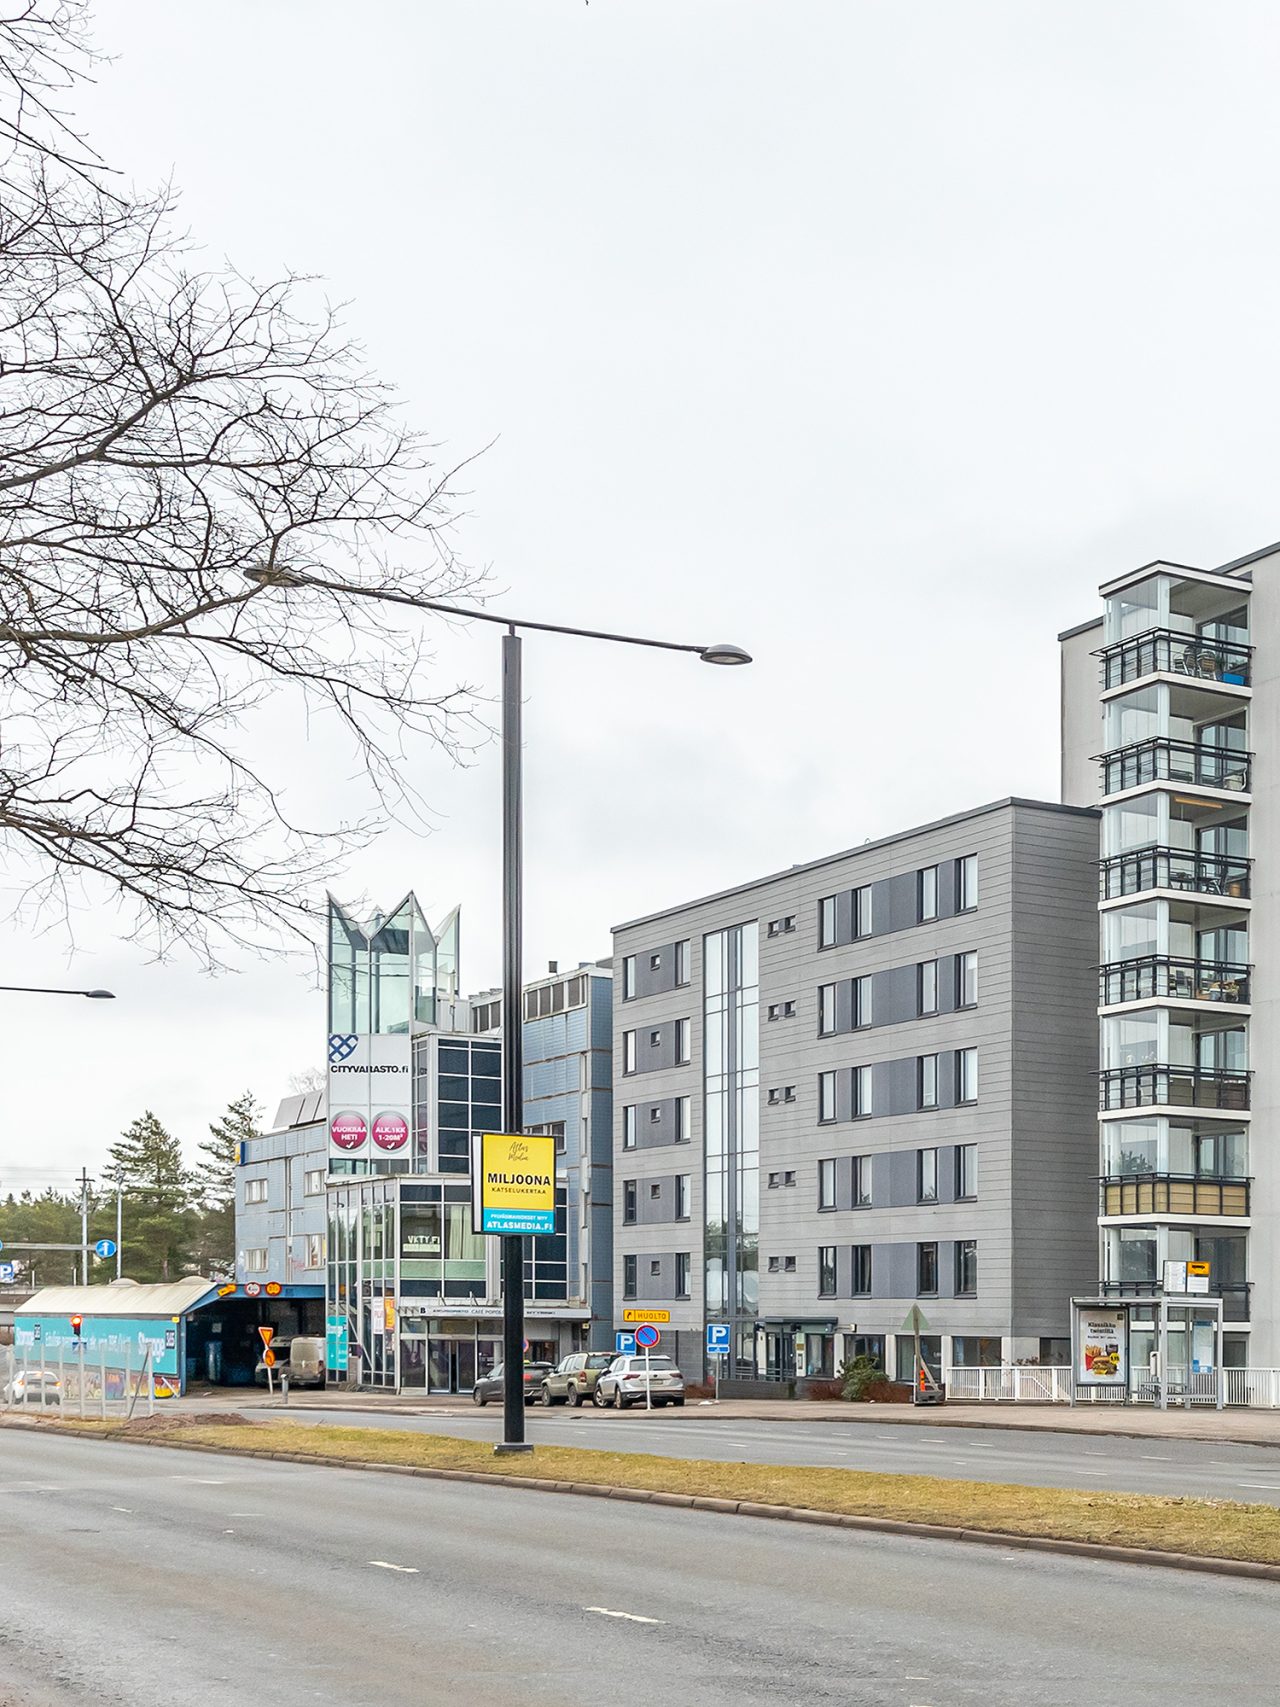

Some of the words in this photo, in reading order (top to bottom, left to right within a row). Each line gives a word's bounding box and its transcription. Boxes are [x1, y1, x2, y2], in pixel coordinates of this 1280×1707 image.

[487, 1173, 551, 1186] MILJOONA
[487, 1221, 552, 1230] ATLASMEDIA.FI
[637, 1312, 668, 1320] HUOLTO
[712, 1326, 727, 1343] P
[620, 1335, 633, 1350] P
